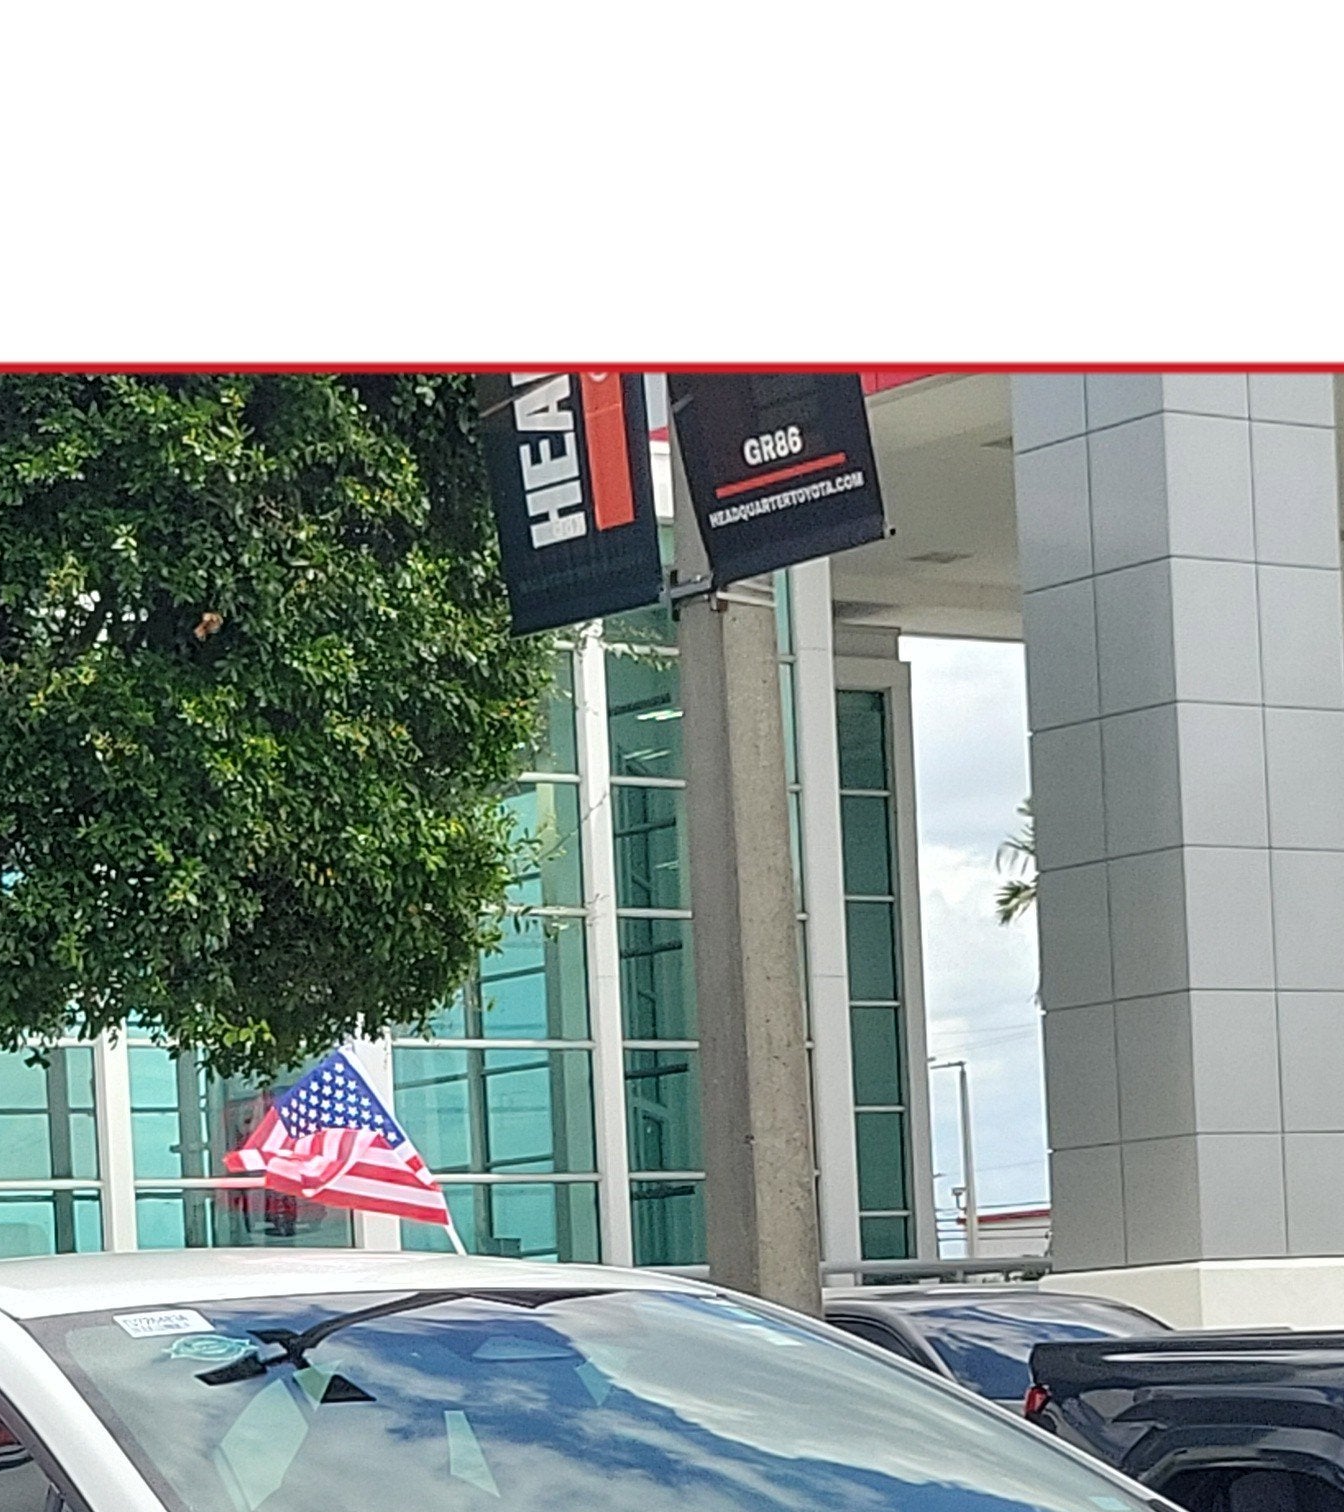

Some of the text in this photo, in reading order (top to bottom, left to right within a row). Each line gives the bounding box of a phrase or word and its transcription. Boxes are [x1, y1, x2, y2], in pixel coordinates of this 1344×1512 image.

[511, 373, 587, 549] HEA
[743, 426, 803, 466] GR86
[709, 471, 864, 528] HEADQUARTERTOYOTA.COM
